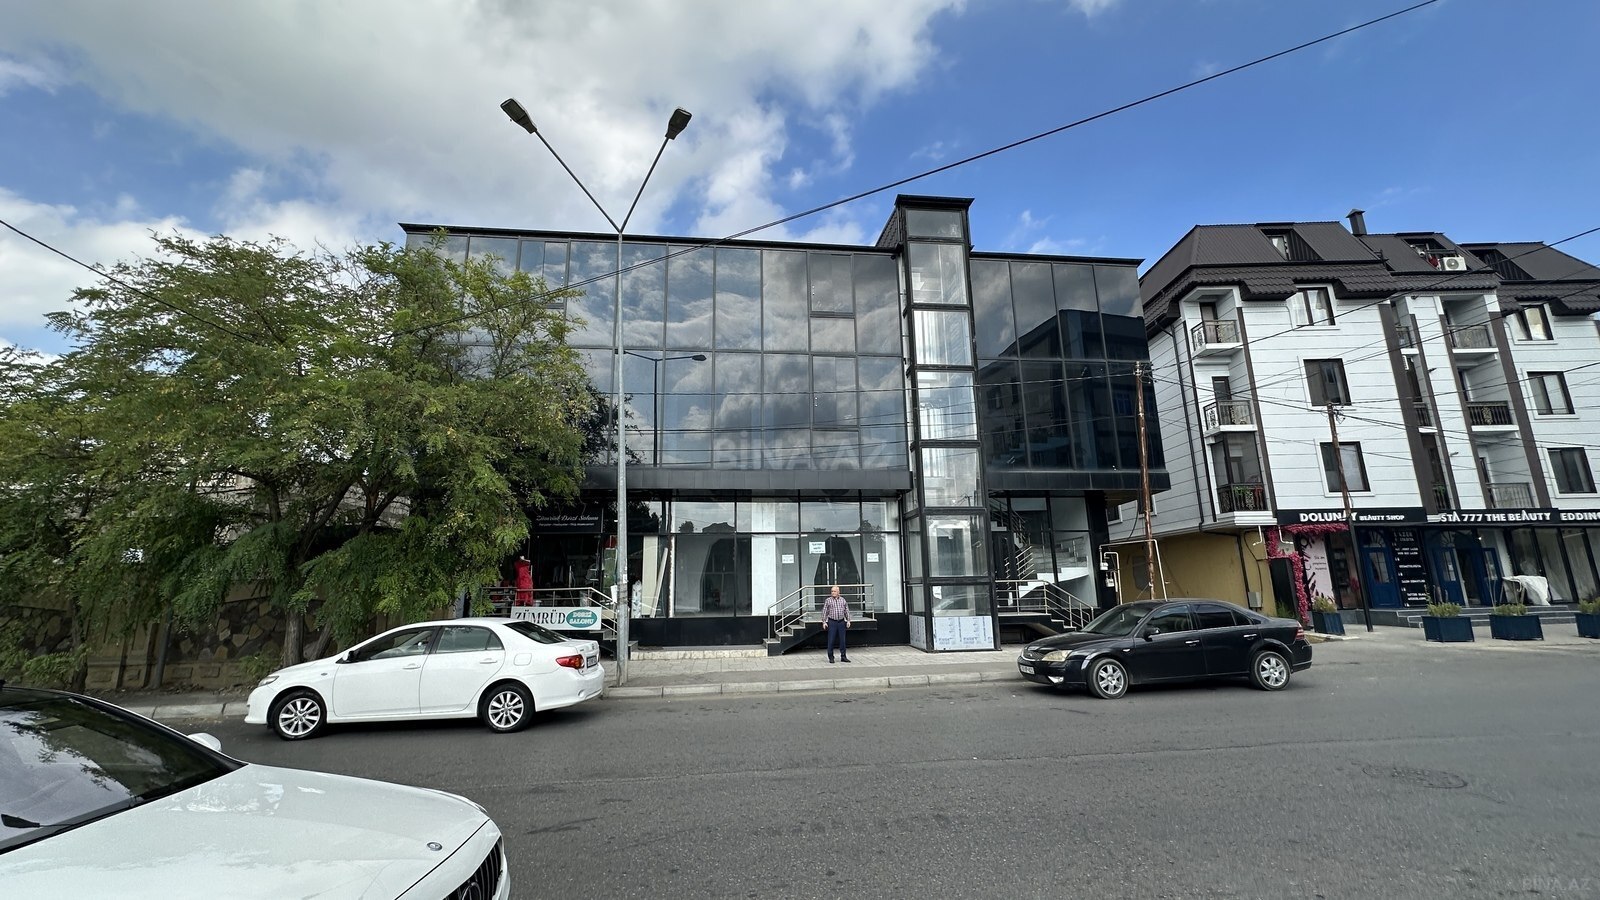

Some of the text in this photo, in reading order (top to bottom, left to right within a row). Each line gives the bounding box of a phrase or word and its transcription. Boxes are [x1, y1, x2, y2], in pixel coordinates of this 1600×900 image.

[1462, 513, 1483, 522] 777
[1485, 513, 1506, 522] THE
[1508, 510, 1551, 522] BEAUTY
[515, 609, 566, 624] ZÜMRÜD
